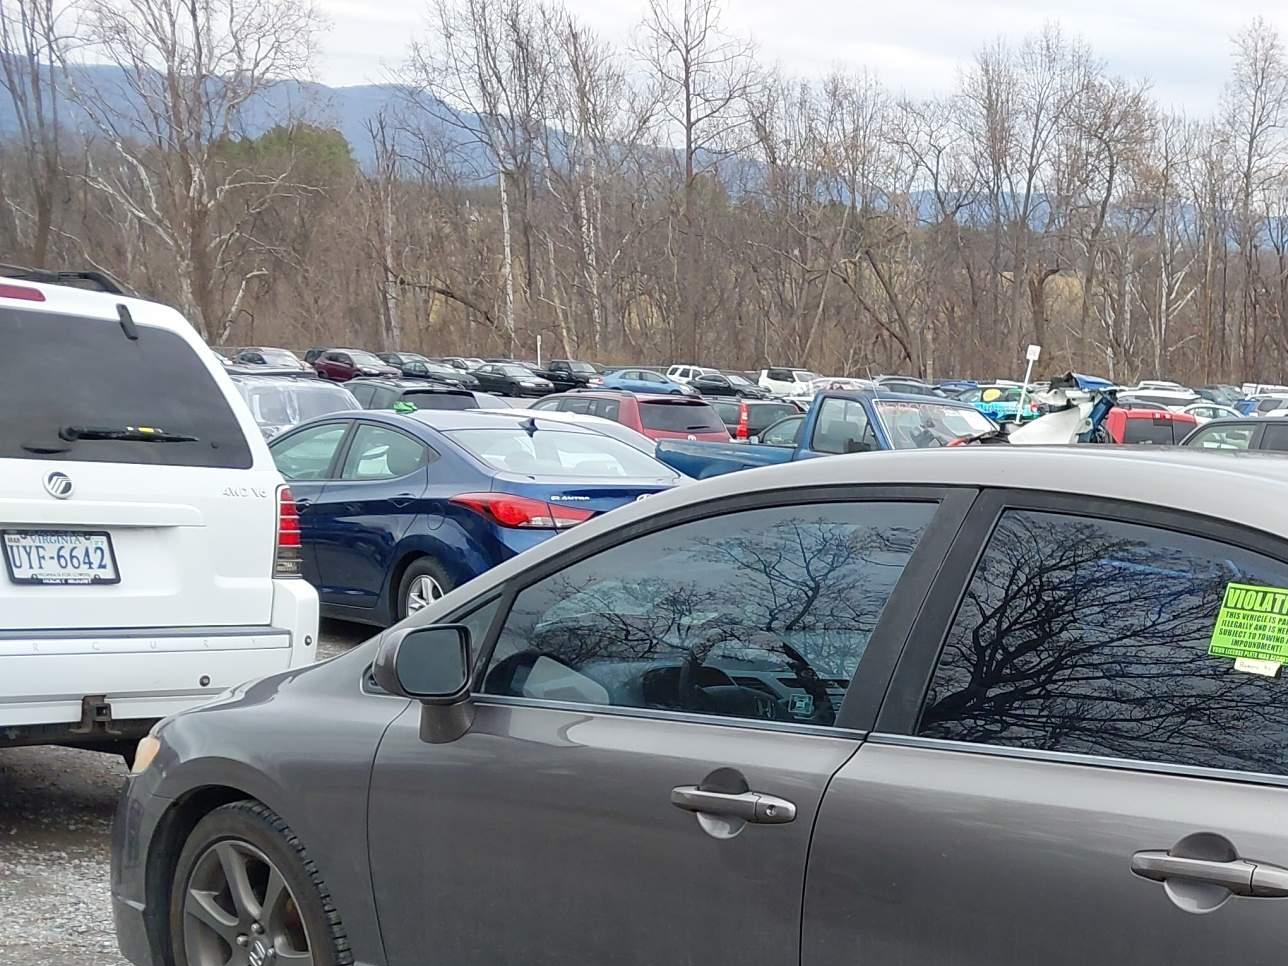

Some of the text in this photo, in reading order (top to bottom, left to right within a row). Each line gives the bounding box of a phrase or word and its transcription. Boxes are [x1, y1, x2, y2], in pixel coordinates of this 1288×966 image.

[30, 533, 82, 545] VIRGINIA
[7, 544, 108, 570] UYF-6642
[1225, 611, 1241, 620] THIS
[1242, 613, 1268, 623] VEHICLE
[1268, 615, 1277, 624] IS
[1221, 619, 1253, 631] ILLEGALLY
[1253, 623, 1267, 632] AND
[1268, 625, 1277, 634] IS
[1218, 628, 1247, 638] SUBJECT
[1248, 631, 1257, 640] TO
[1257, 633, 1285, 644] TOWING
[1231, 638, 1283, 652] IMPOUNDMENT!
